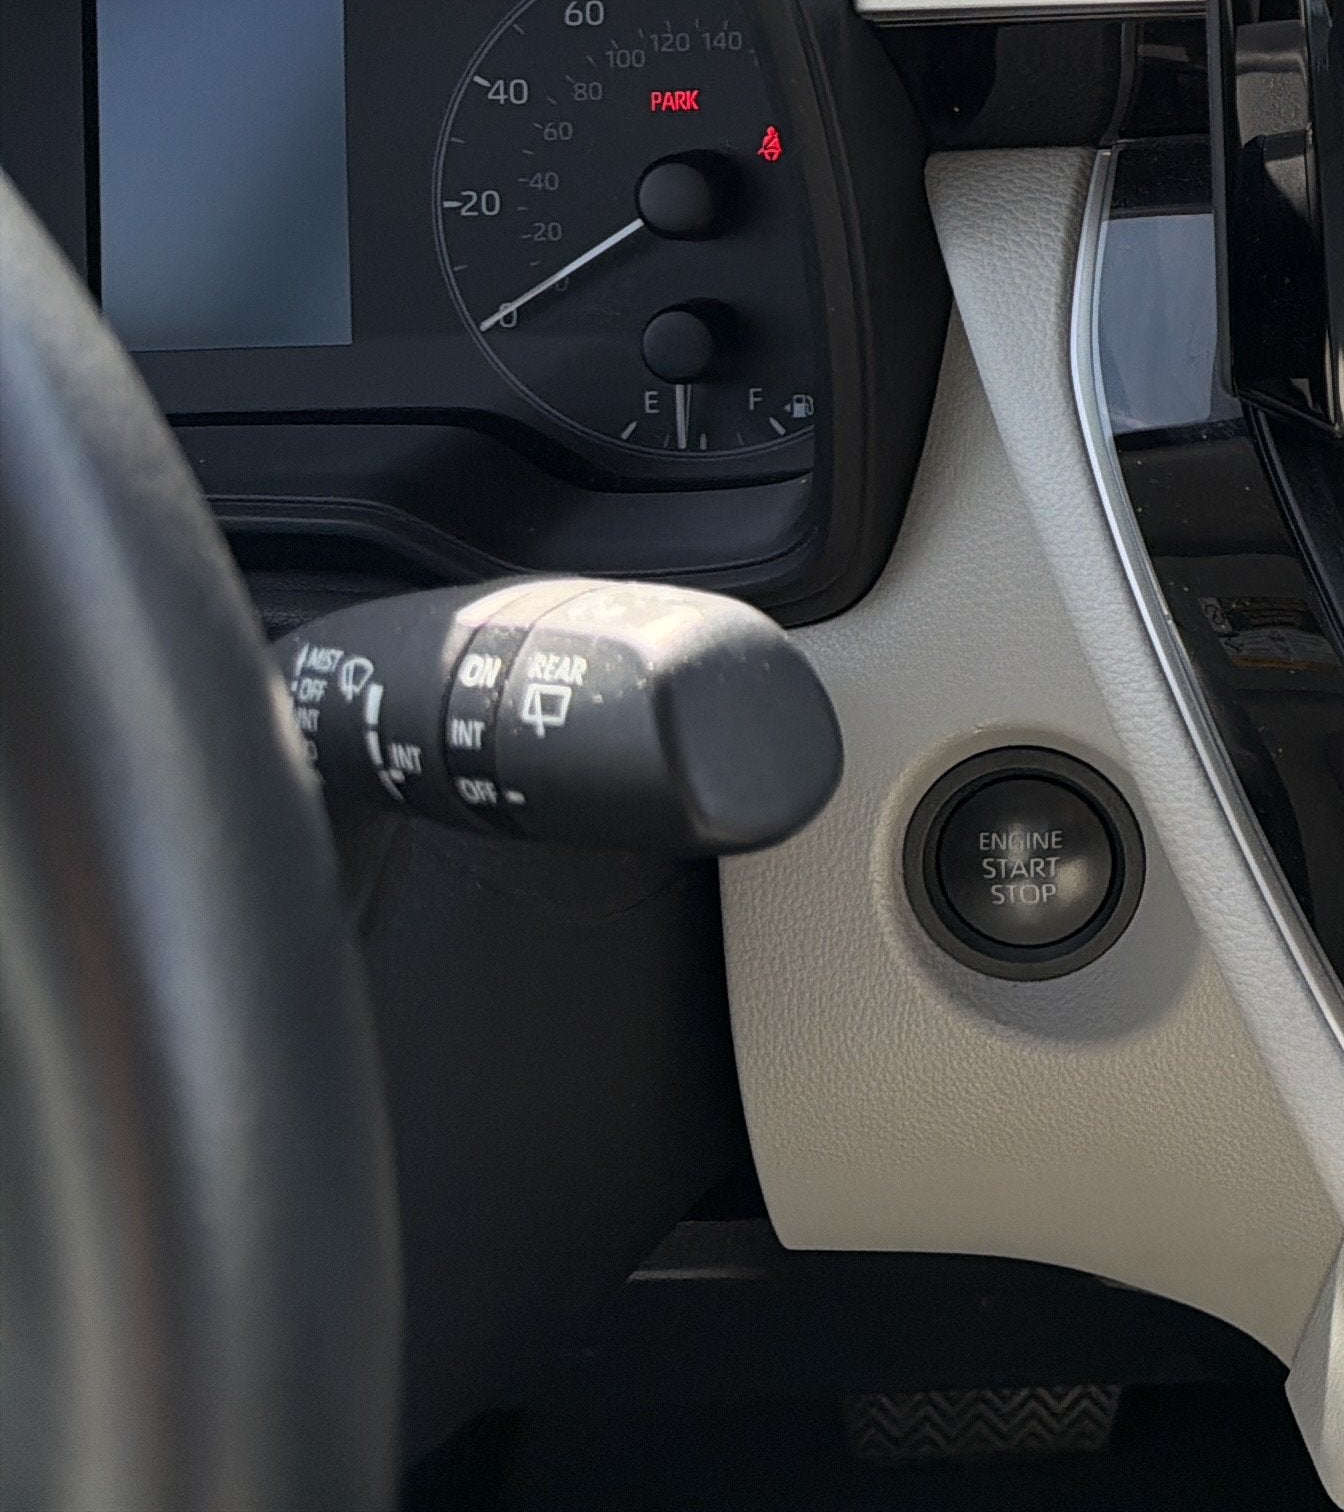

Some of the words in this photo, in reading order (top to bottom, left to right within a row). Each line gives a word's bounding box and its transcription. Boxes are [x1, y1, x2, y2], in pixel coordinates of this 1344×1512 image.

[564, 0, 605, 26] 60
[649, 32, 690, 53] 120
[702, 31, 742, 51] 140
[605, 48, 646, 70] 100
[487, 78, 529, 105] 40
[573, 82, 603, 102] 80
[650, 90, 700, 111] PARK
[542, 121, 574, 142] 60
[530, 170, 560, 191] 40
[460, 190, 501, 216] 20
[533, 221, 563, 242] 20
[644, 391, 660, 413] E
[748, 388, 762, 410] F
[458, 652, 502, 688] ON
[526, 651, 588, 687] REAR
[299, 678, 328, 703] OFF
[451, 718, 486, 751] INT
[388, 742, 422, 775] INT
[455, 775, 498, 807] OFF
[979, 830, 1064, 851] ENGINE
[982, 856, 1061, 879] START
[991, 883, 1057, 905] STOP
